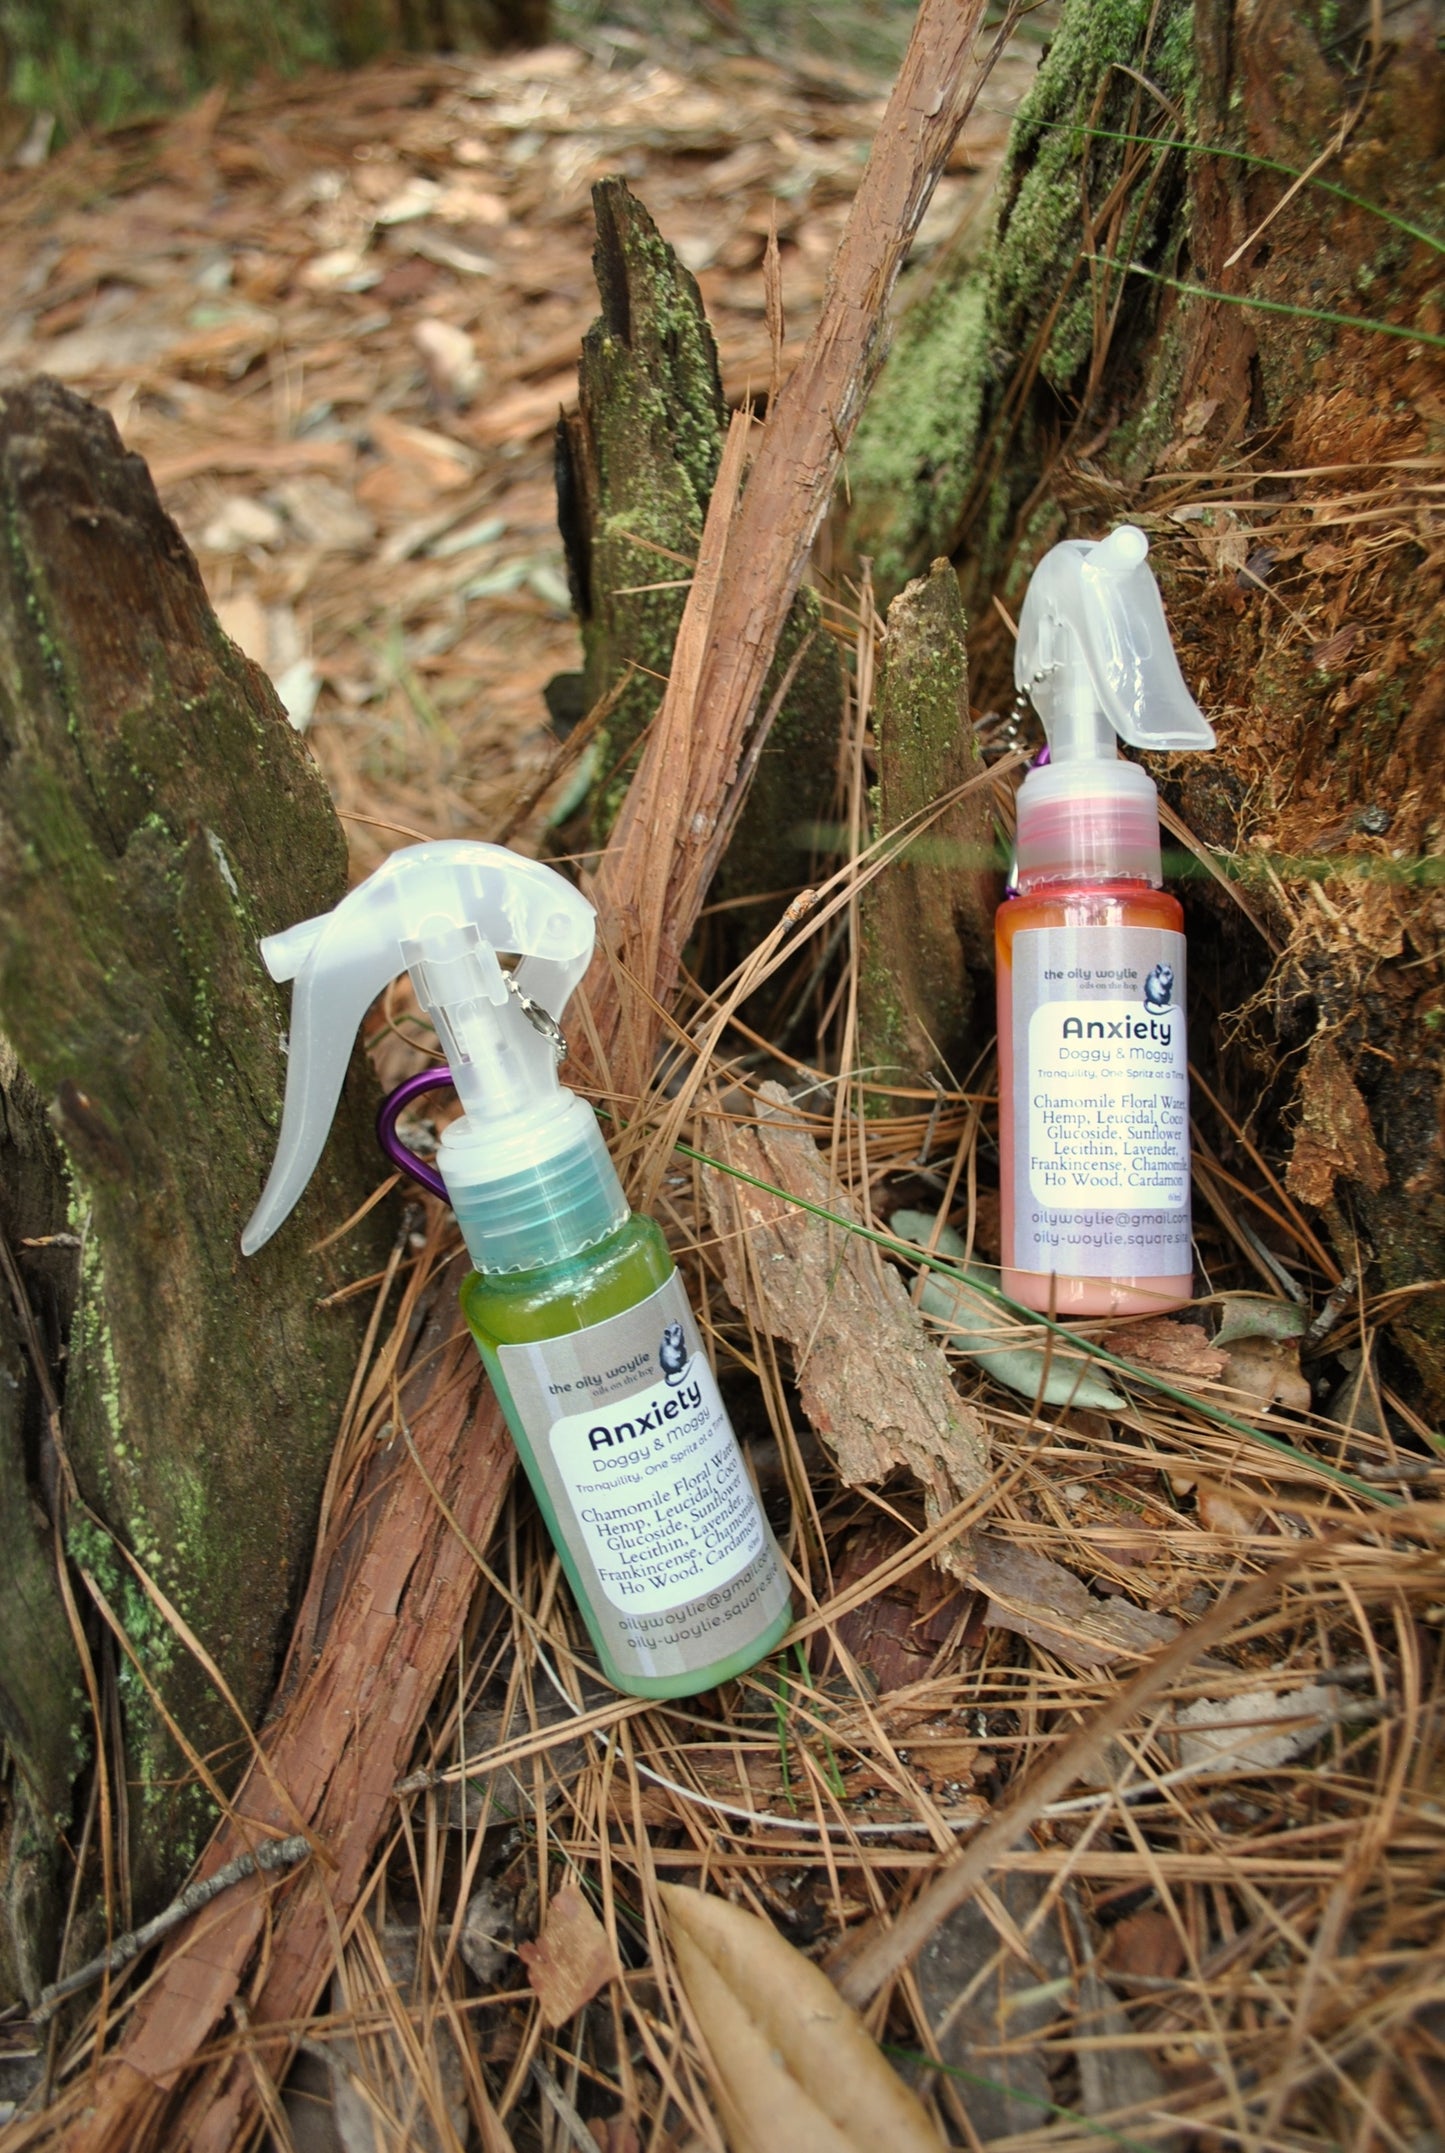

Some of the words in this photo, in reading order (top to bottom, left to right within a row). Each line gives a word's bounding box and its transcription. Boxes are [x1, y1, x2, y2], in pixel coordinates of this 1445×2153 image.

[1044, 970, 1063, 979] the
[1068, 968, 1091, 980] oily
[1095, 969, 1137, 980] woylie
[1063, 1015, 1171, 1045] Anxiety
[1060, 1048, 1111, 1061] Doggy
[1116, 1048, 1124, 1059] &
[1130, 1048, 1173, 1063] Moggy
[1101, 1069, 1123, 1078] One
[1127, 1069, 1153, 1080] Spritz
[1034, 1094, 1115, 1109] Chamomile
[1121, 1094, 1157, 1109] Floral
[1043, 1111, 1090, 1128] Hemp,
[1097, 1110, 1158, 1127] Leucidal,
[1160, 1111, 1183, 1125] Coco
[1047, 1127, 1122, 1141] Glucoside,
[1128, 1126, 1182, 1141] Sunflower
[1031, 1157, 1127, 1172] Frankincense,
[1054, 1142, 1118, 1156] Lecithin,
[1123, 1142, 1178, 1156] Lavender,
[1045, 1173, 1066, 1186] Ho
[1072, 1172, 1123, 1187] Wood,
[1128, 1172, 1183, 1187] Cardamon
[549, 1385, 573, 1395] the
[576, 1373, 602, 1389] oily
[606, 1352, 650, 1380] woylie
[588, 1381, 701, 1451] Anxiety
[593, 1445, 651, 1472] Doggy
[654, 1439, 665, 1452] &
[667, 1407, 711, 1443] Moggy
[645, 1461, 669, 1476] One
[670, 1443, 698, 1464] Spritz
[581, 1490, 671, 1524] Chamomile
[673, 1464, 711, 1496] Floral
[596, 1519, 651, 1538] Hemp,
[654, 1485, 718, 1523] Leucidal,
[715, 1458, 740, 1485] Coco
[607, 1520, 689, 1552] Glucoside,
[690, 1475, 741, 1523] Sunflower
[619, 1538, 689, 1565] Lecithin,
[691, 1495, 744, 1541] Lavender,
[599, 1549, 702, 1583] Frankincense,
[620, 1582, 645, 1595] Ho
[648, 1561, 704, 1590] Wood,
[705, 1517, 758, 1567] Cardamon
